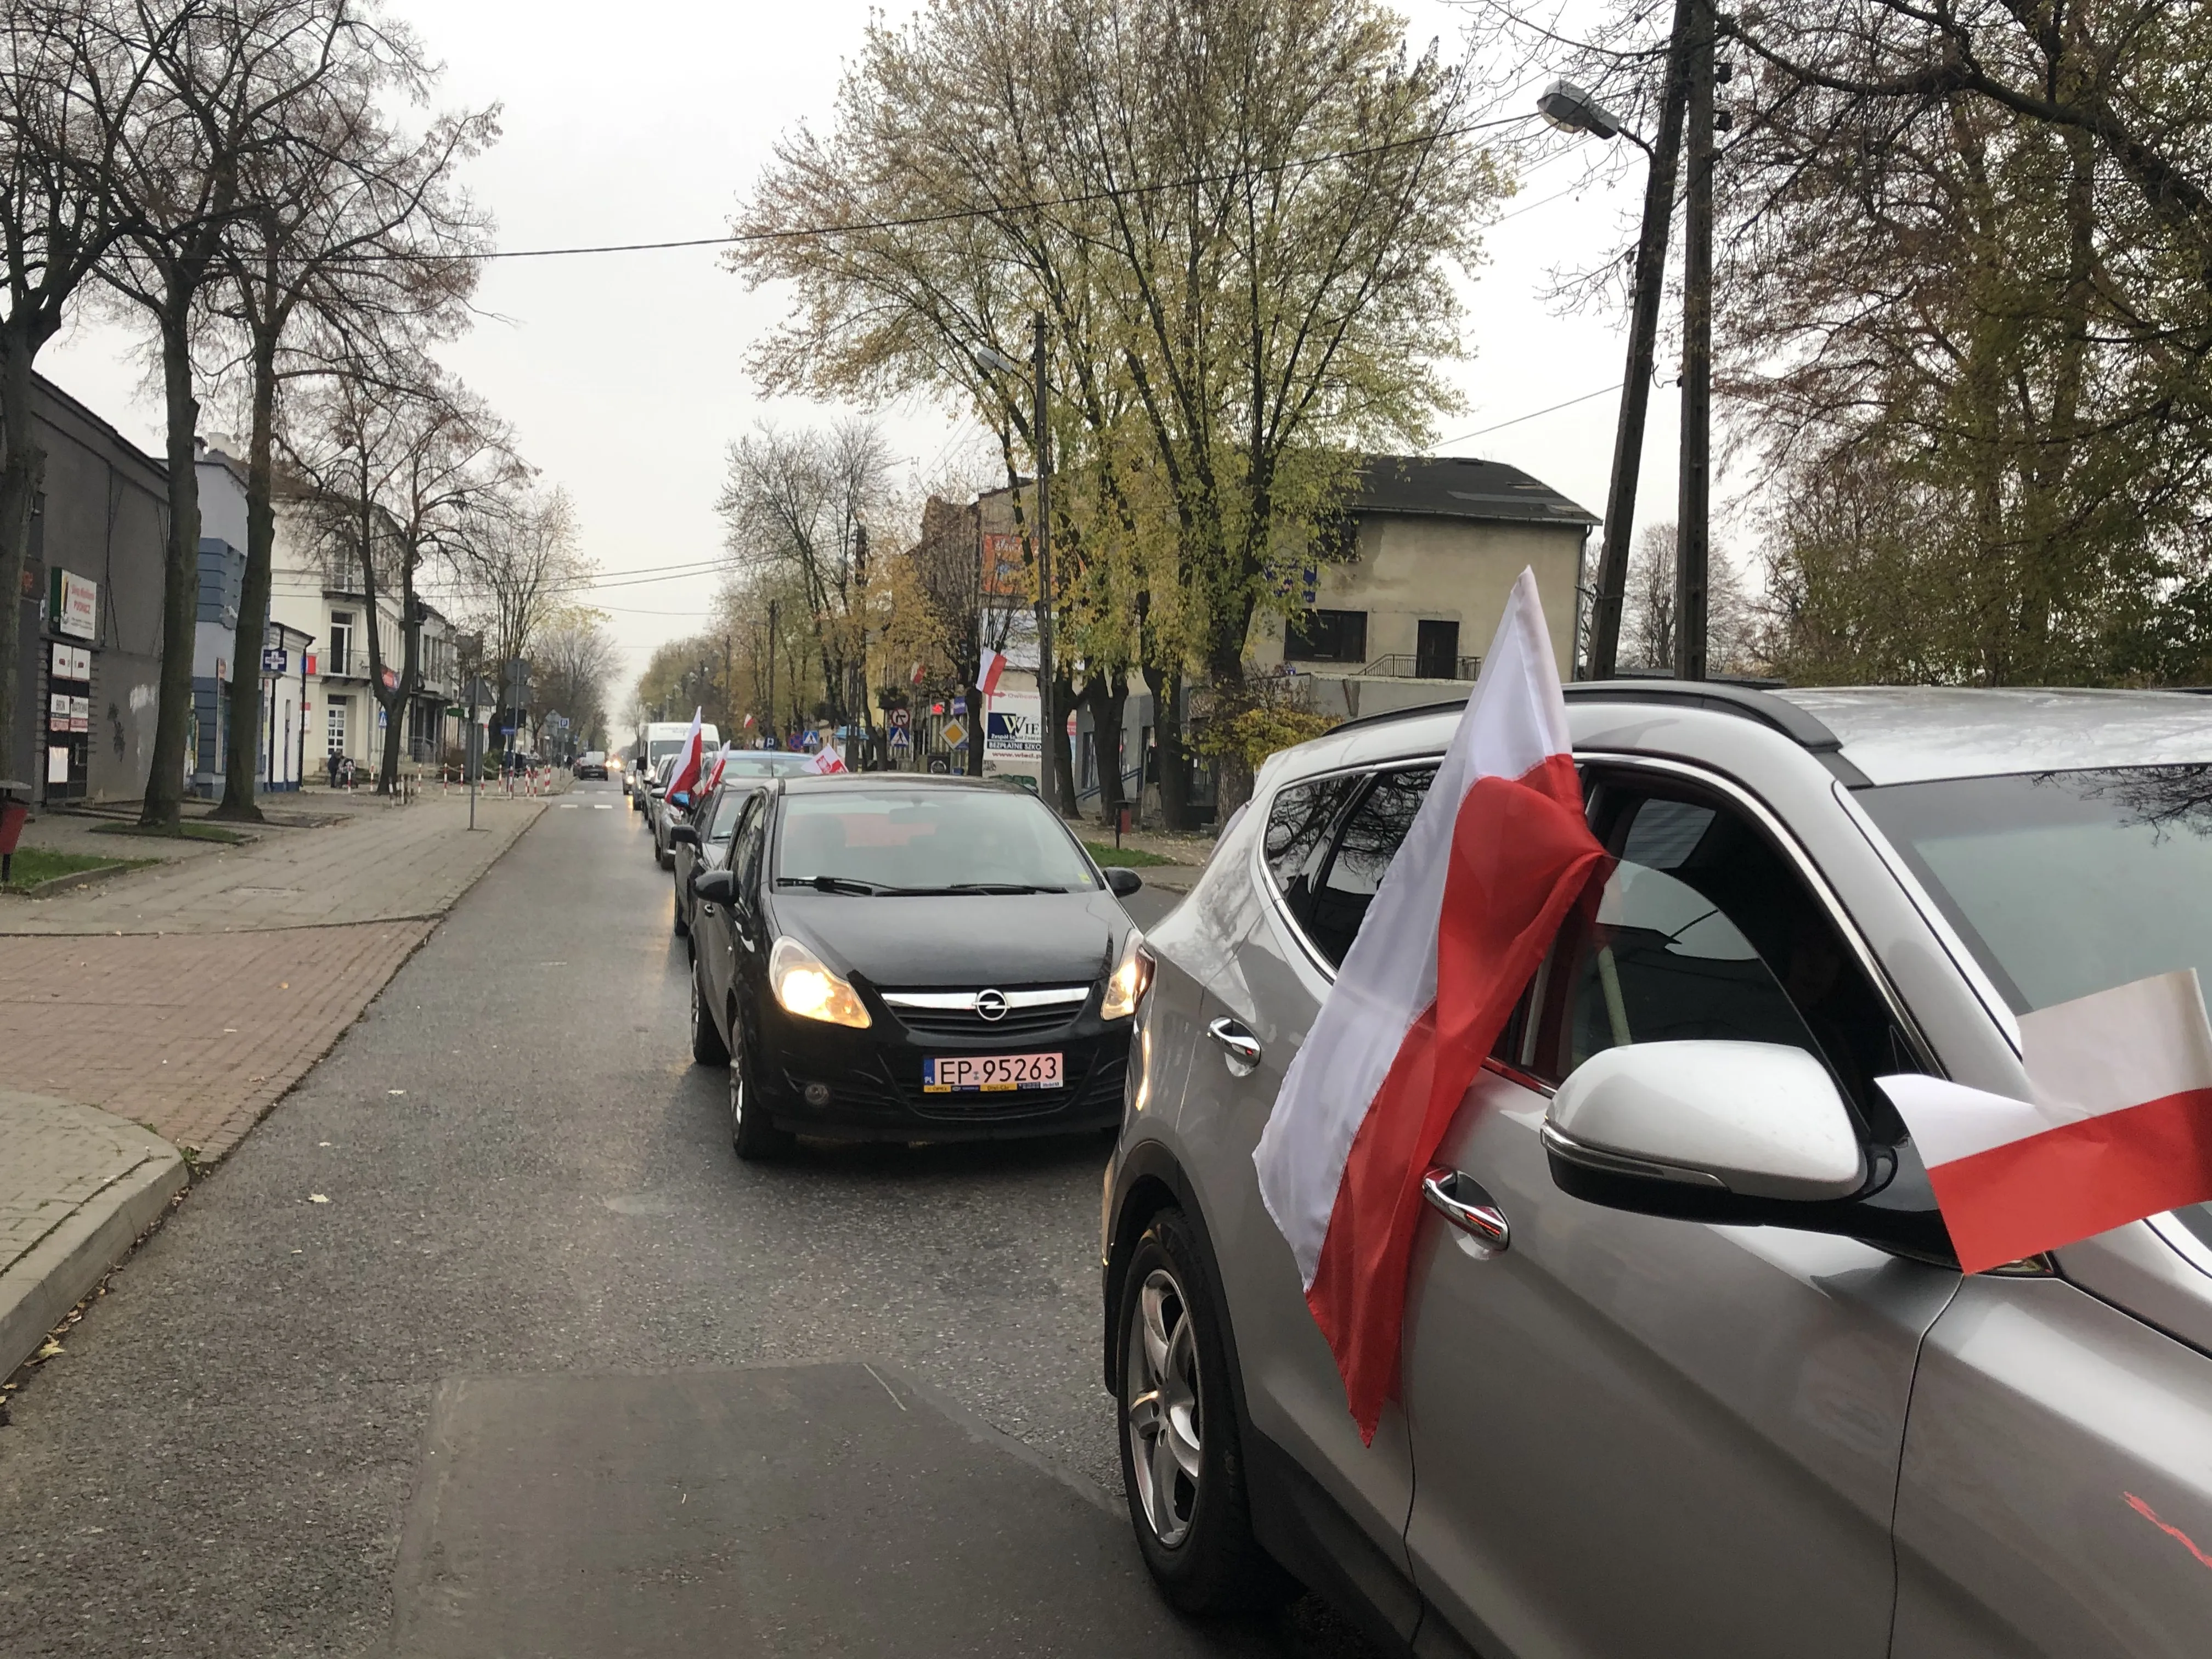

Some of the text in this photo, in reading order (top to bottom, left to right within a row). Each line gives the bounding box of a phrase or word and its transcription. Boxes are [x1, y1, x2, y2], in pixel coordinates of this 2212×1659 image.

[1002, 715, 1040, 734] WIE
[1024, 743, 1042, 751] SZKO
[940, 1056, 1057, 1085] EP 95263
[924, 1076, 934, 1084] PL
